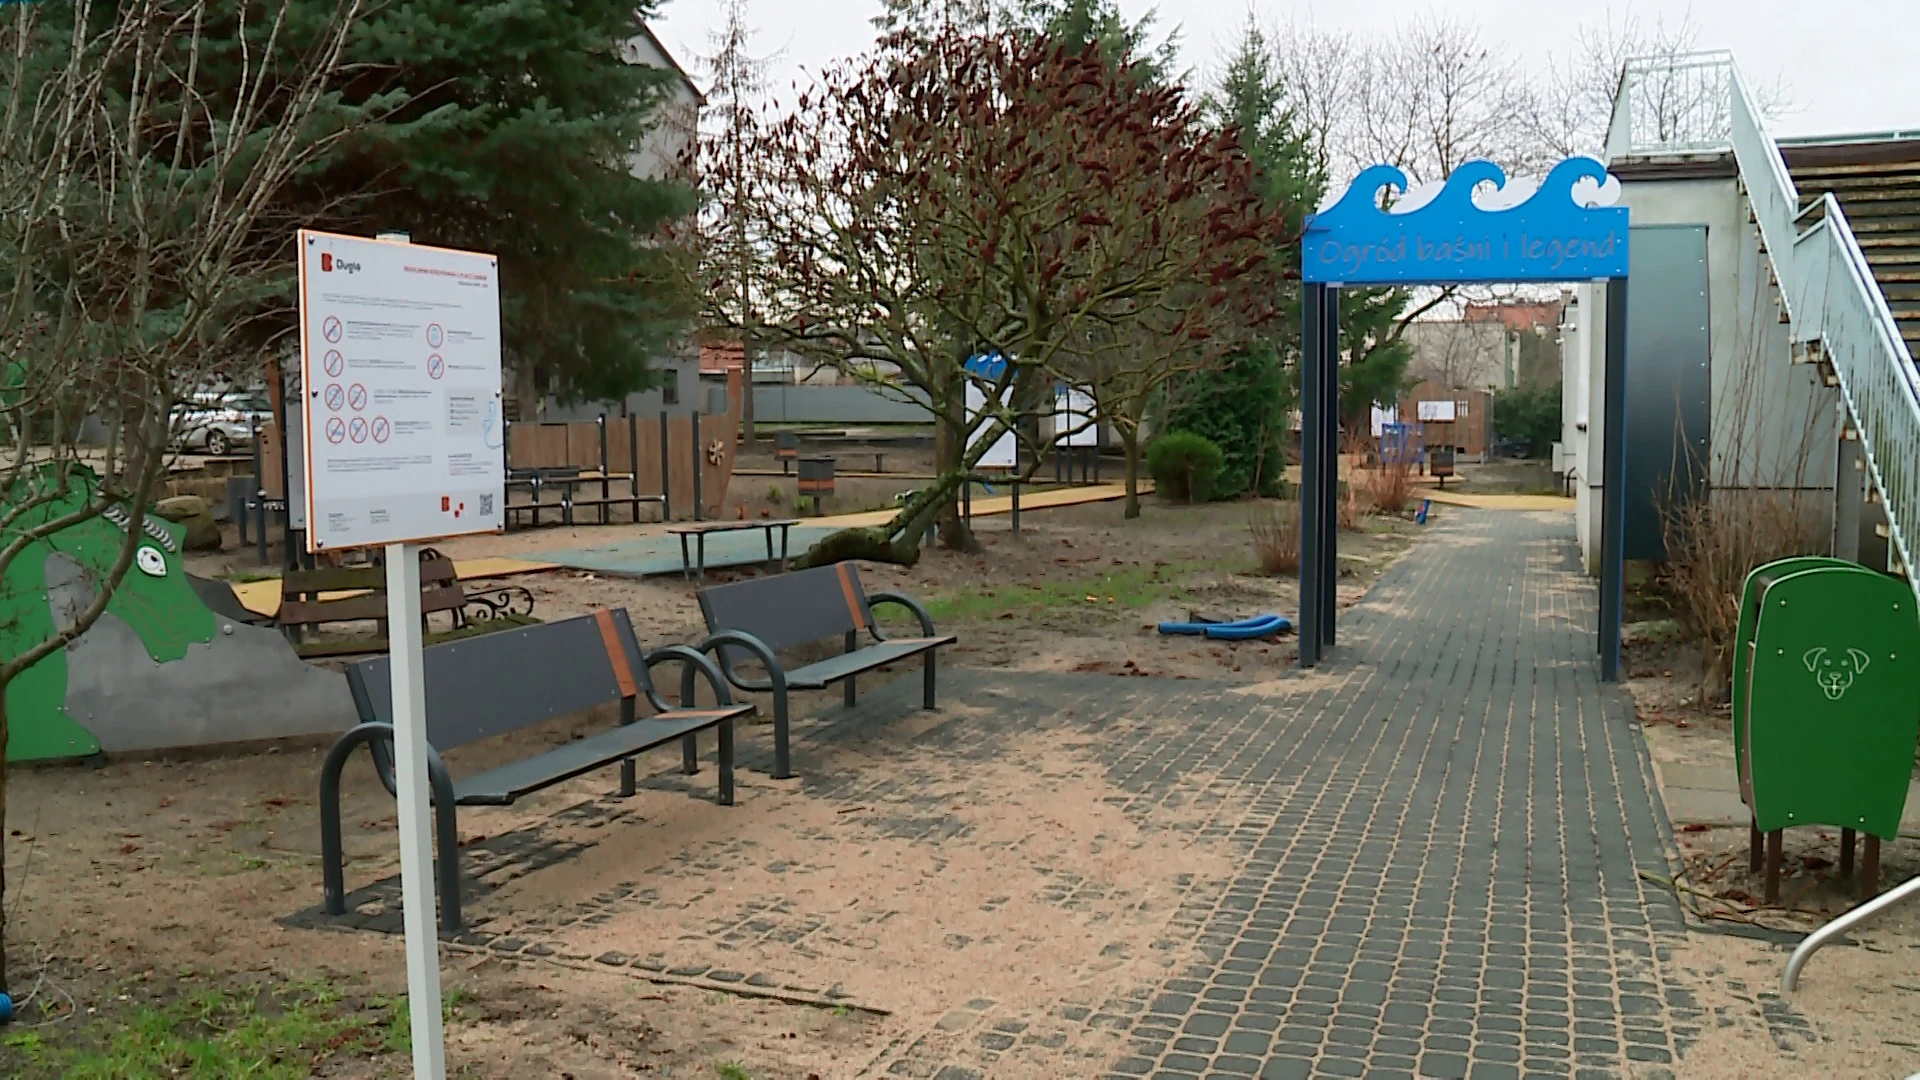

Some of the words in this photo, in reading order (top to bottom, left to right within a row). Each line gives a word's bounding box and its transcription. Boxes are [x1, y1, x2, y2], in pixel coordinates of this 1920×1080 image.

[1319, 234, 1406, 274] Ogród
[1416, 234, 1491, 263] baśni
[1503, 232, 1509, 260] i
[1521, 229, 1616, 270] legend
